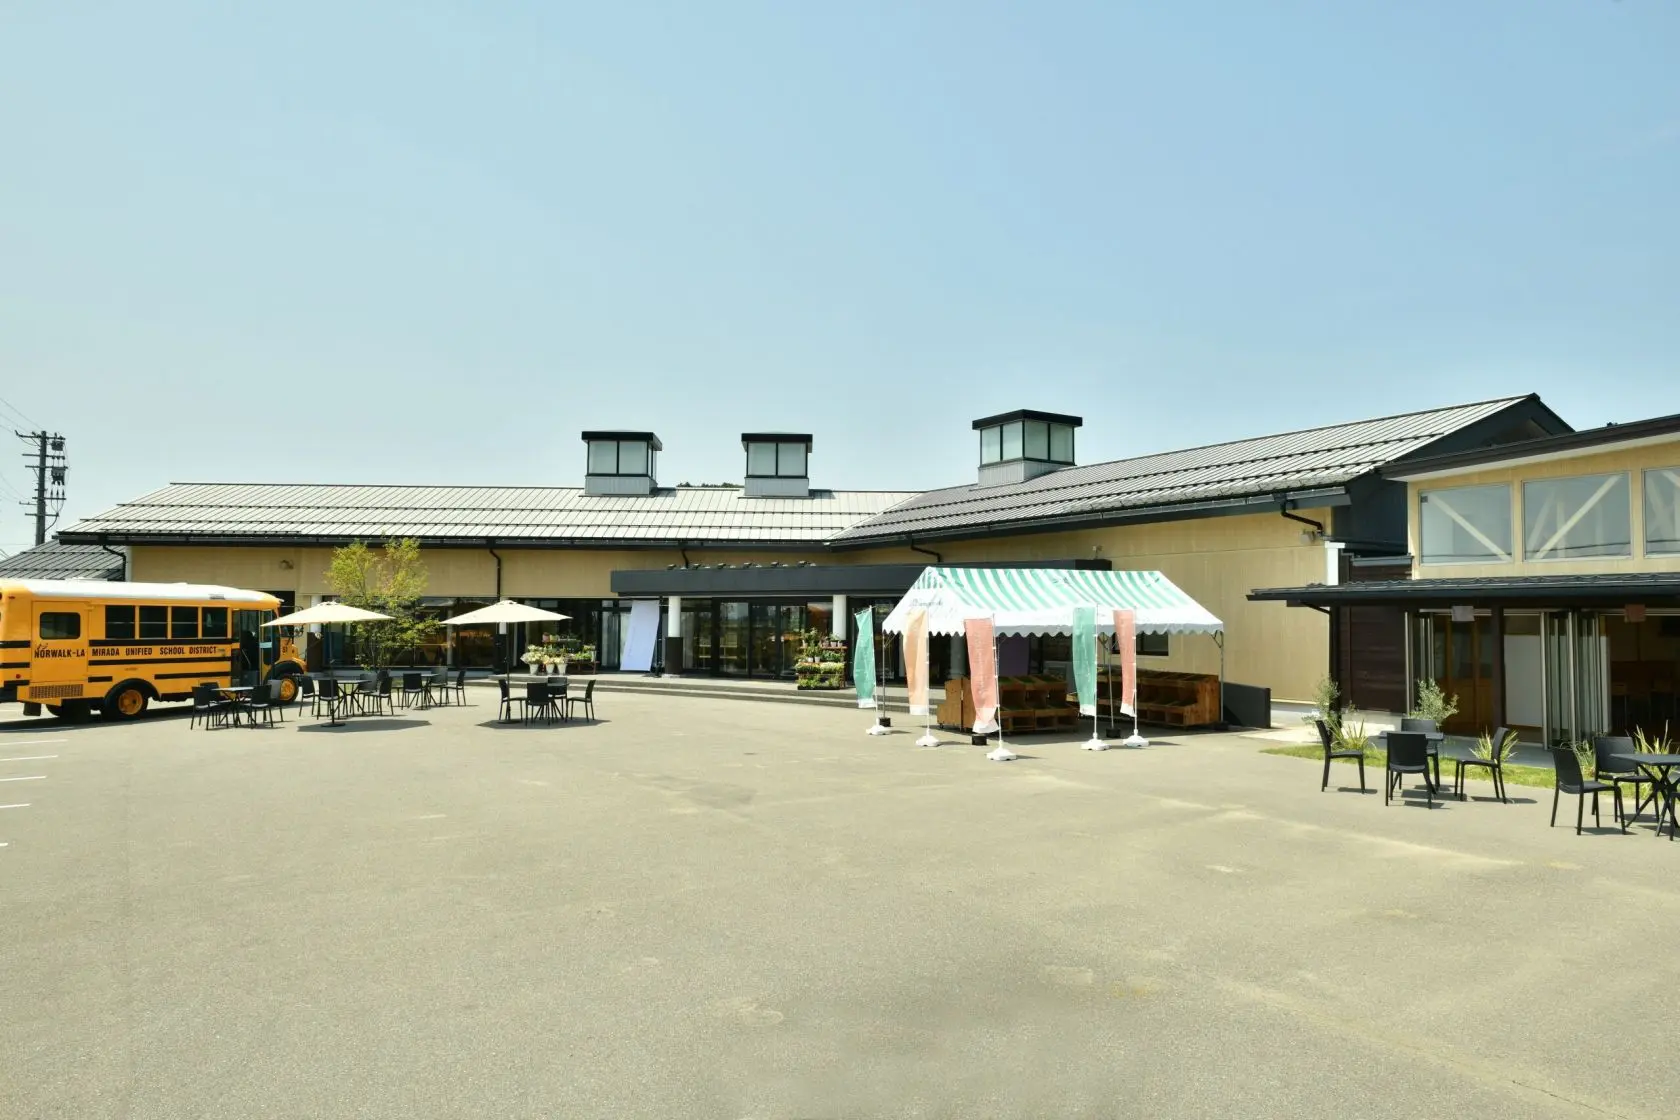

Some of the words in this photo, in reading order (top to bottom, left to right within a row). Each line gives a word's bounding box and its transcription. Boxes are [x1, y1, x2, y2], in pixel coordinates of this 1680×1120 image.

[34, 649, 85, 658] NORWALK-LA
[91, 648, 120, 656] MIRADA
[125, 647, 153, 656] UNIFIED
[159, 646, 185, 655] SCHOOL
[189, 646, 217, 654] DISTRICT
